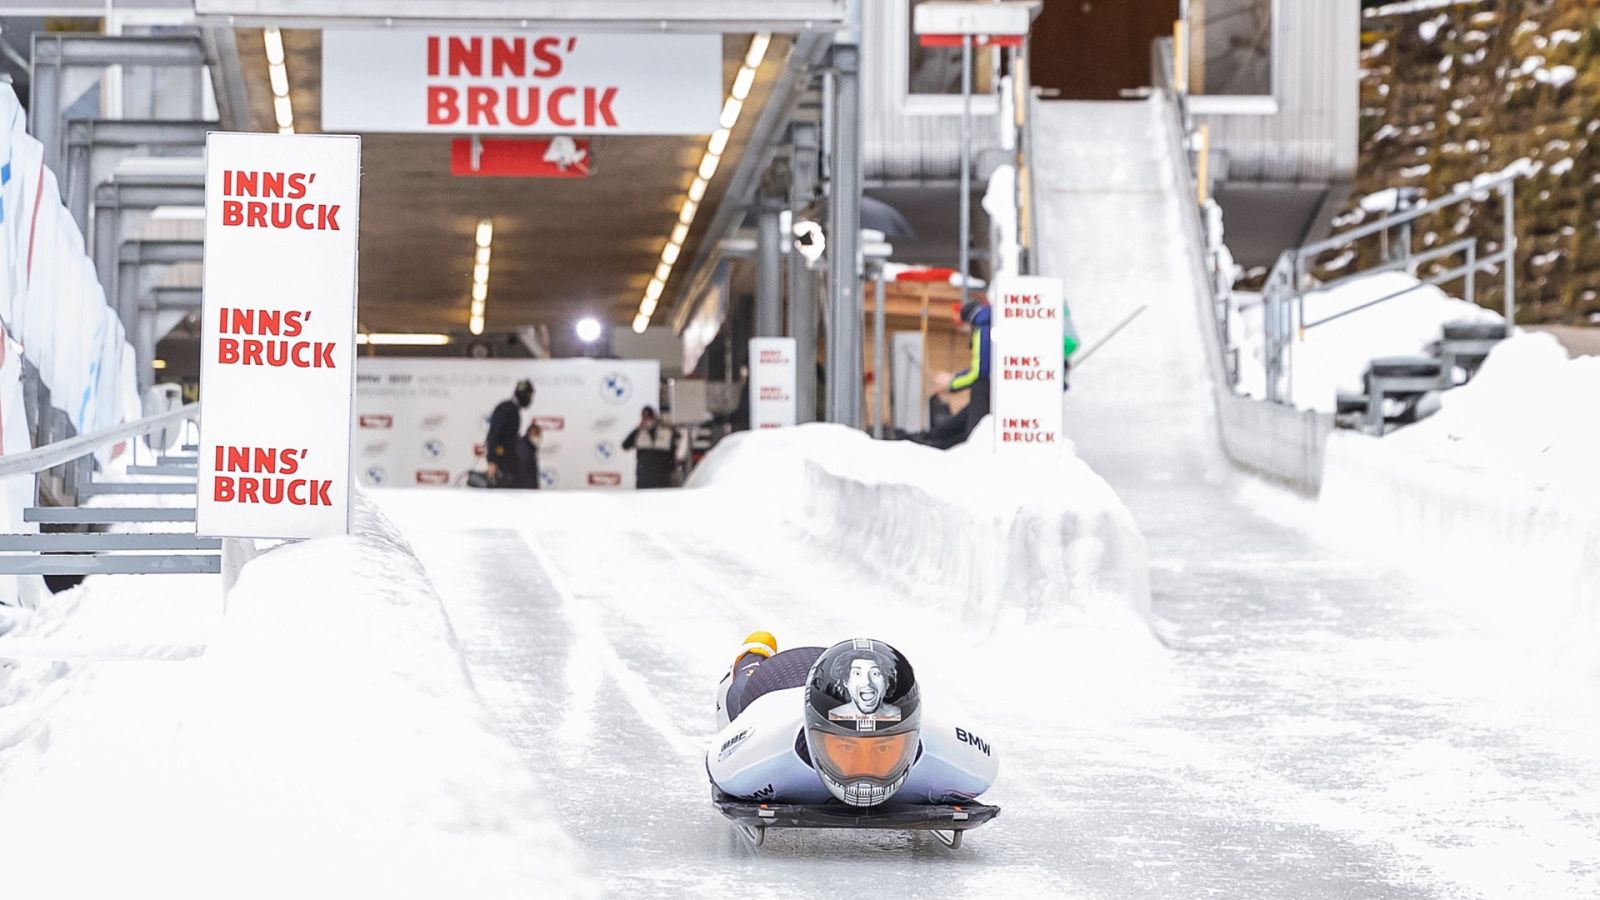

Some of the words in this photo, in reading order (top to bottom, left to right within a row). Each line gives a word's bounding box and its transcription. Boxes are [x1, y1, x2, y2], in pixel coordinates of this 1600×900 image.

[426, 35, 577, 79] INNS'
[426, 85, 619, 128] BRUCK
[222, 169, 316, 200] INNS'
[222, 199, 341, 231] BRUCK
[218, 307, 311, 338] INNS'
[1003, 307, 1056, 319] BRUCK
[217, 337, 336, 369] BRUCK
[1003, 369, 1055, 381] BRUCK
[1002, 431, 1055, 443] BRUCK
[214, 445, 308, 476] INNS'
[213, 475, 332, 507] BRUCK
[955, 726, 991, 757] BMW
